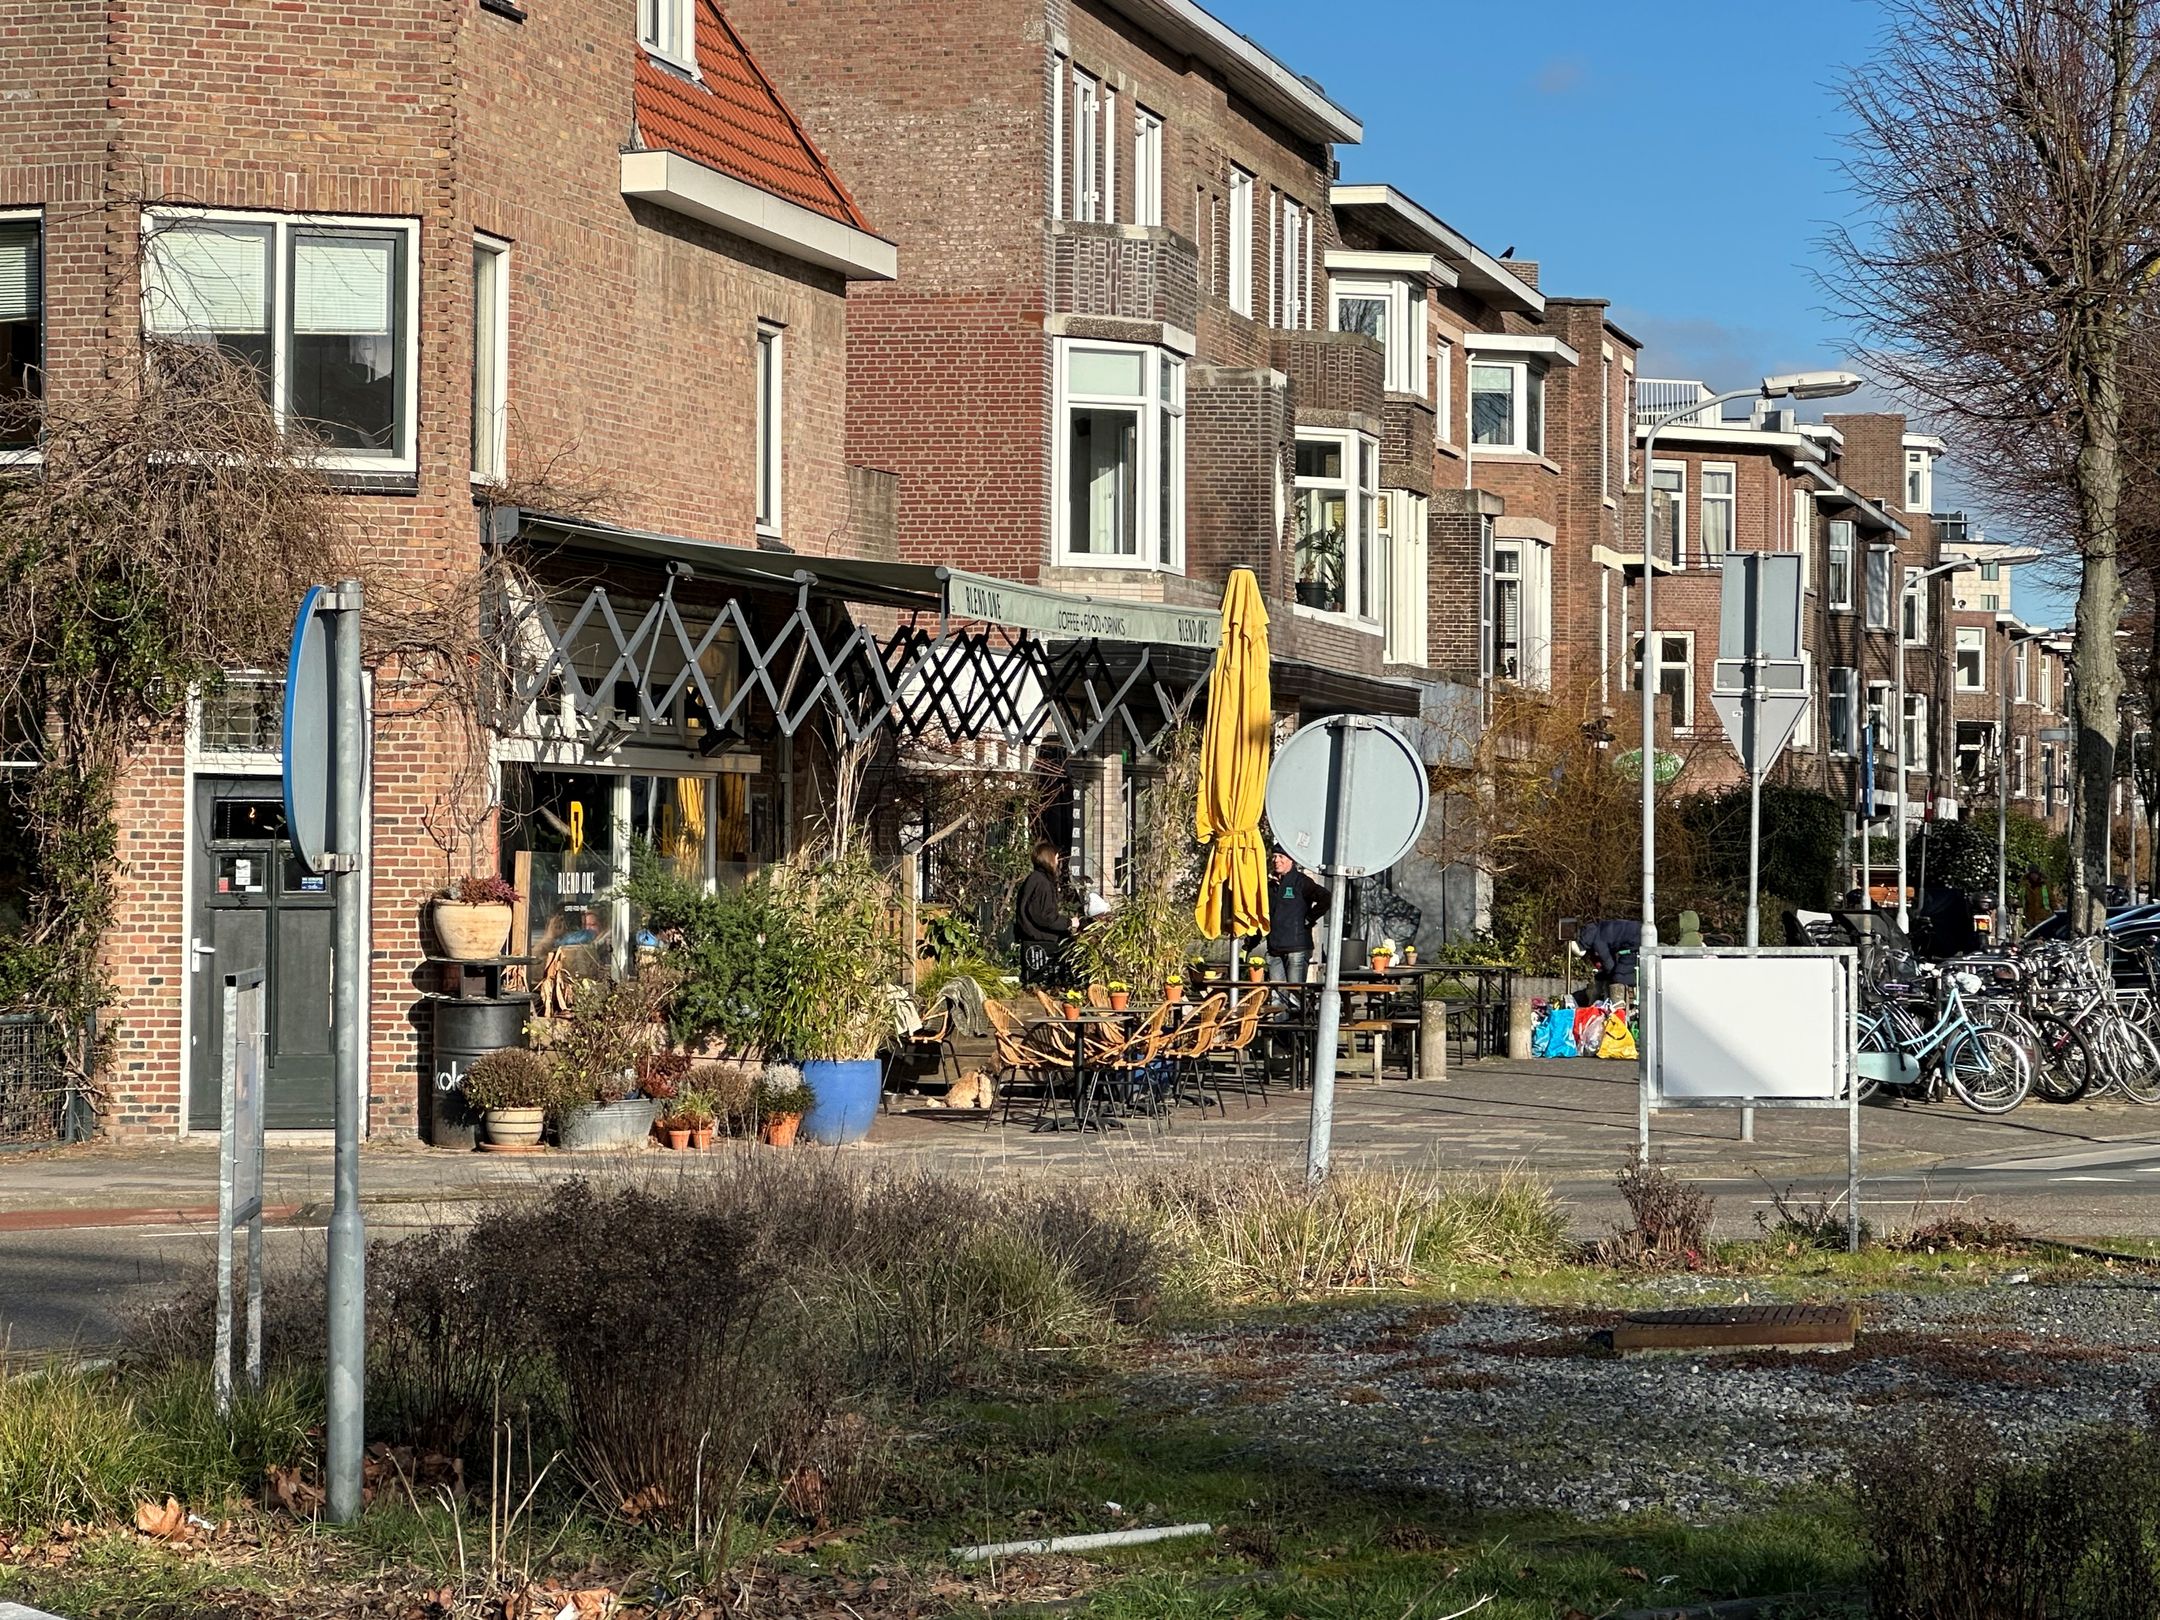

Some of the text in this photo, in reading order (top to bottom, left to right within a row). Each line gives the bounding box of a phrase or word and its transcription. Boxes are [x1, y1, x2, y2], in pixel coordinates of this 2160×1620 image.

[965, 586, 1002, 620] BLEND ONE
[1058, 610, 1126, 636] COFFEE FOOD DRINKS
[1178, 618, 1197, 643] BLEND
[557, 871, 595, 895] BLEND ONE
